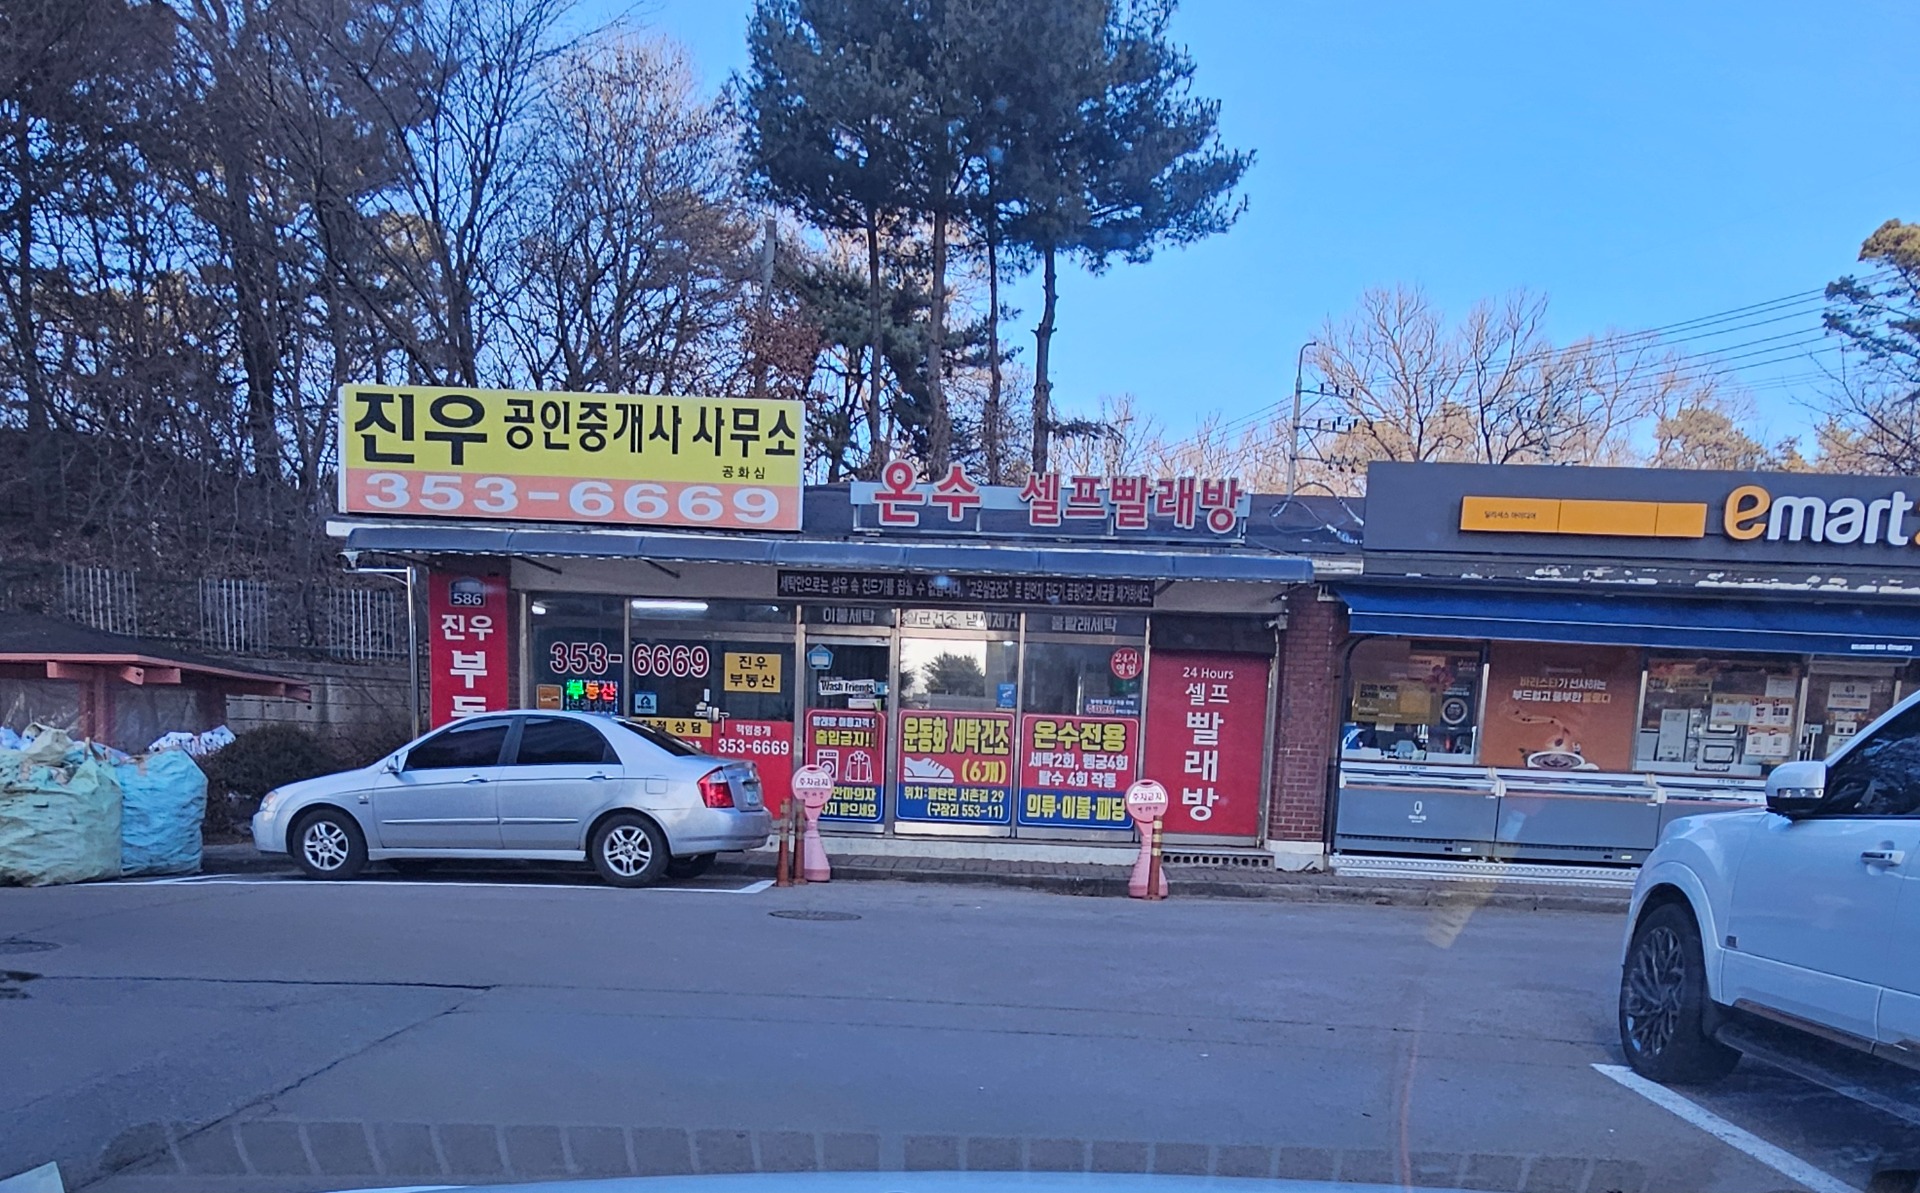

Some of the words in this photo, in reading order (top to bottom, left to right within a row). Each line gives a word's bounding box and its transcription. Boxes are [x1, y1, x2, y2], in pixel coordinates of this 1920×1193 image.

[354, 392, 487, 465] 진우
[503, 398, 681, 455] 공인중개사
[692, 406, 797, 458] 사무소
[722, 465, 766, 480] 공화심
[365, 472, 779, 524] 353-6669
[871, 459, 983, 527] 온수
[1724, 485, 1920, 548] emart
[916, 580, 925, 596] 수
[453, 592, 482, 605] 586
[441, 614, 493, 641] 진우
[739, 655, 768, 670] 진우
[730, 673, 775, 688] 부동산
[1182, 667, 1198, 678] 24
[1201, 667, 1234, 680] Hours
[1185, 682, 1230, 706] 셀프
[736, 723, 771, 737] 책임중개
[903, 716, 949, 754] 운동화
[950, 718, 1010, 755] 세탁건조
[1033, 720, 1126, 752] 온수전용
[718, 738, 789, 755] 353-6669
[961, 758, 1007, 784] (6개)
[1029, 751, 1079, 771] 세탁2회,
[1181, 711, 1225, 821] 빨래방
[991, 790, 1005, 803] 29
[962, 803, 1003, 819] 553-11)
